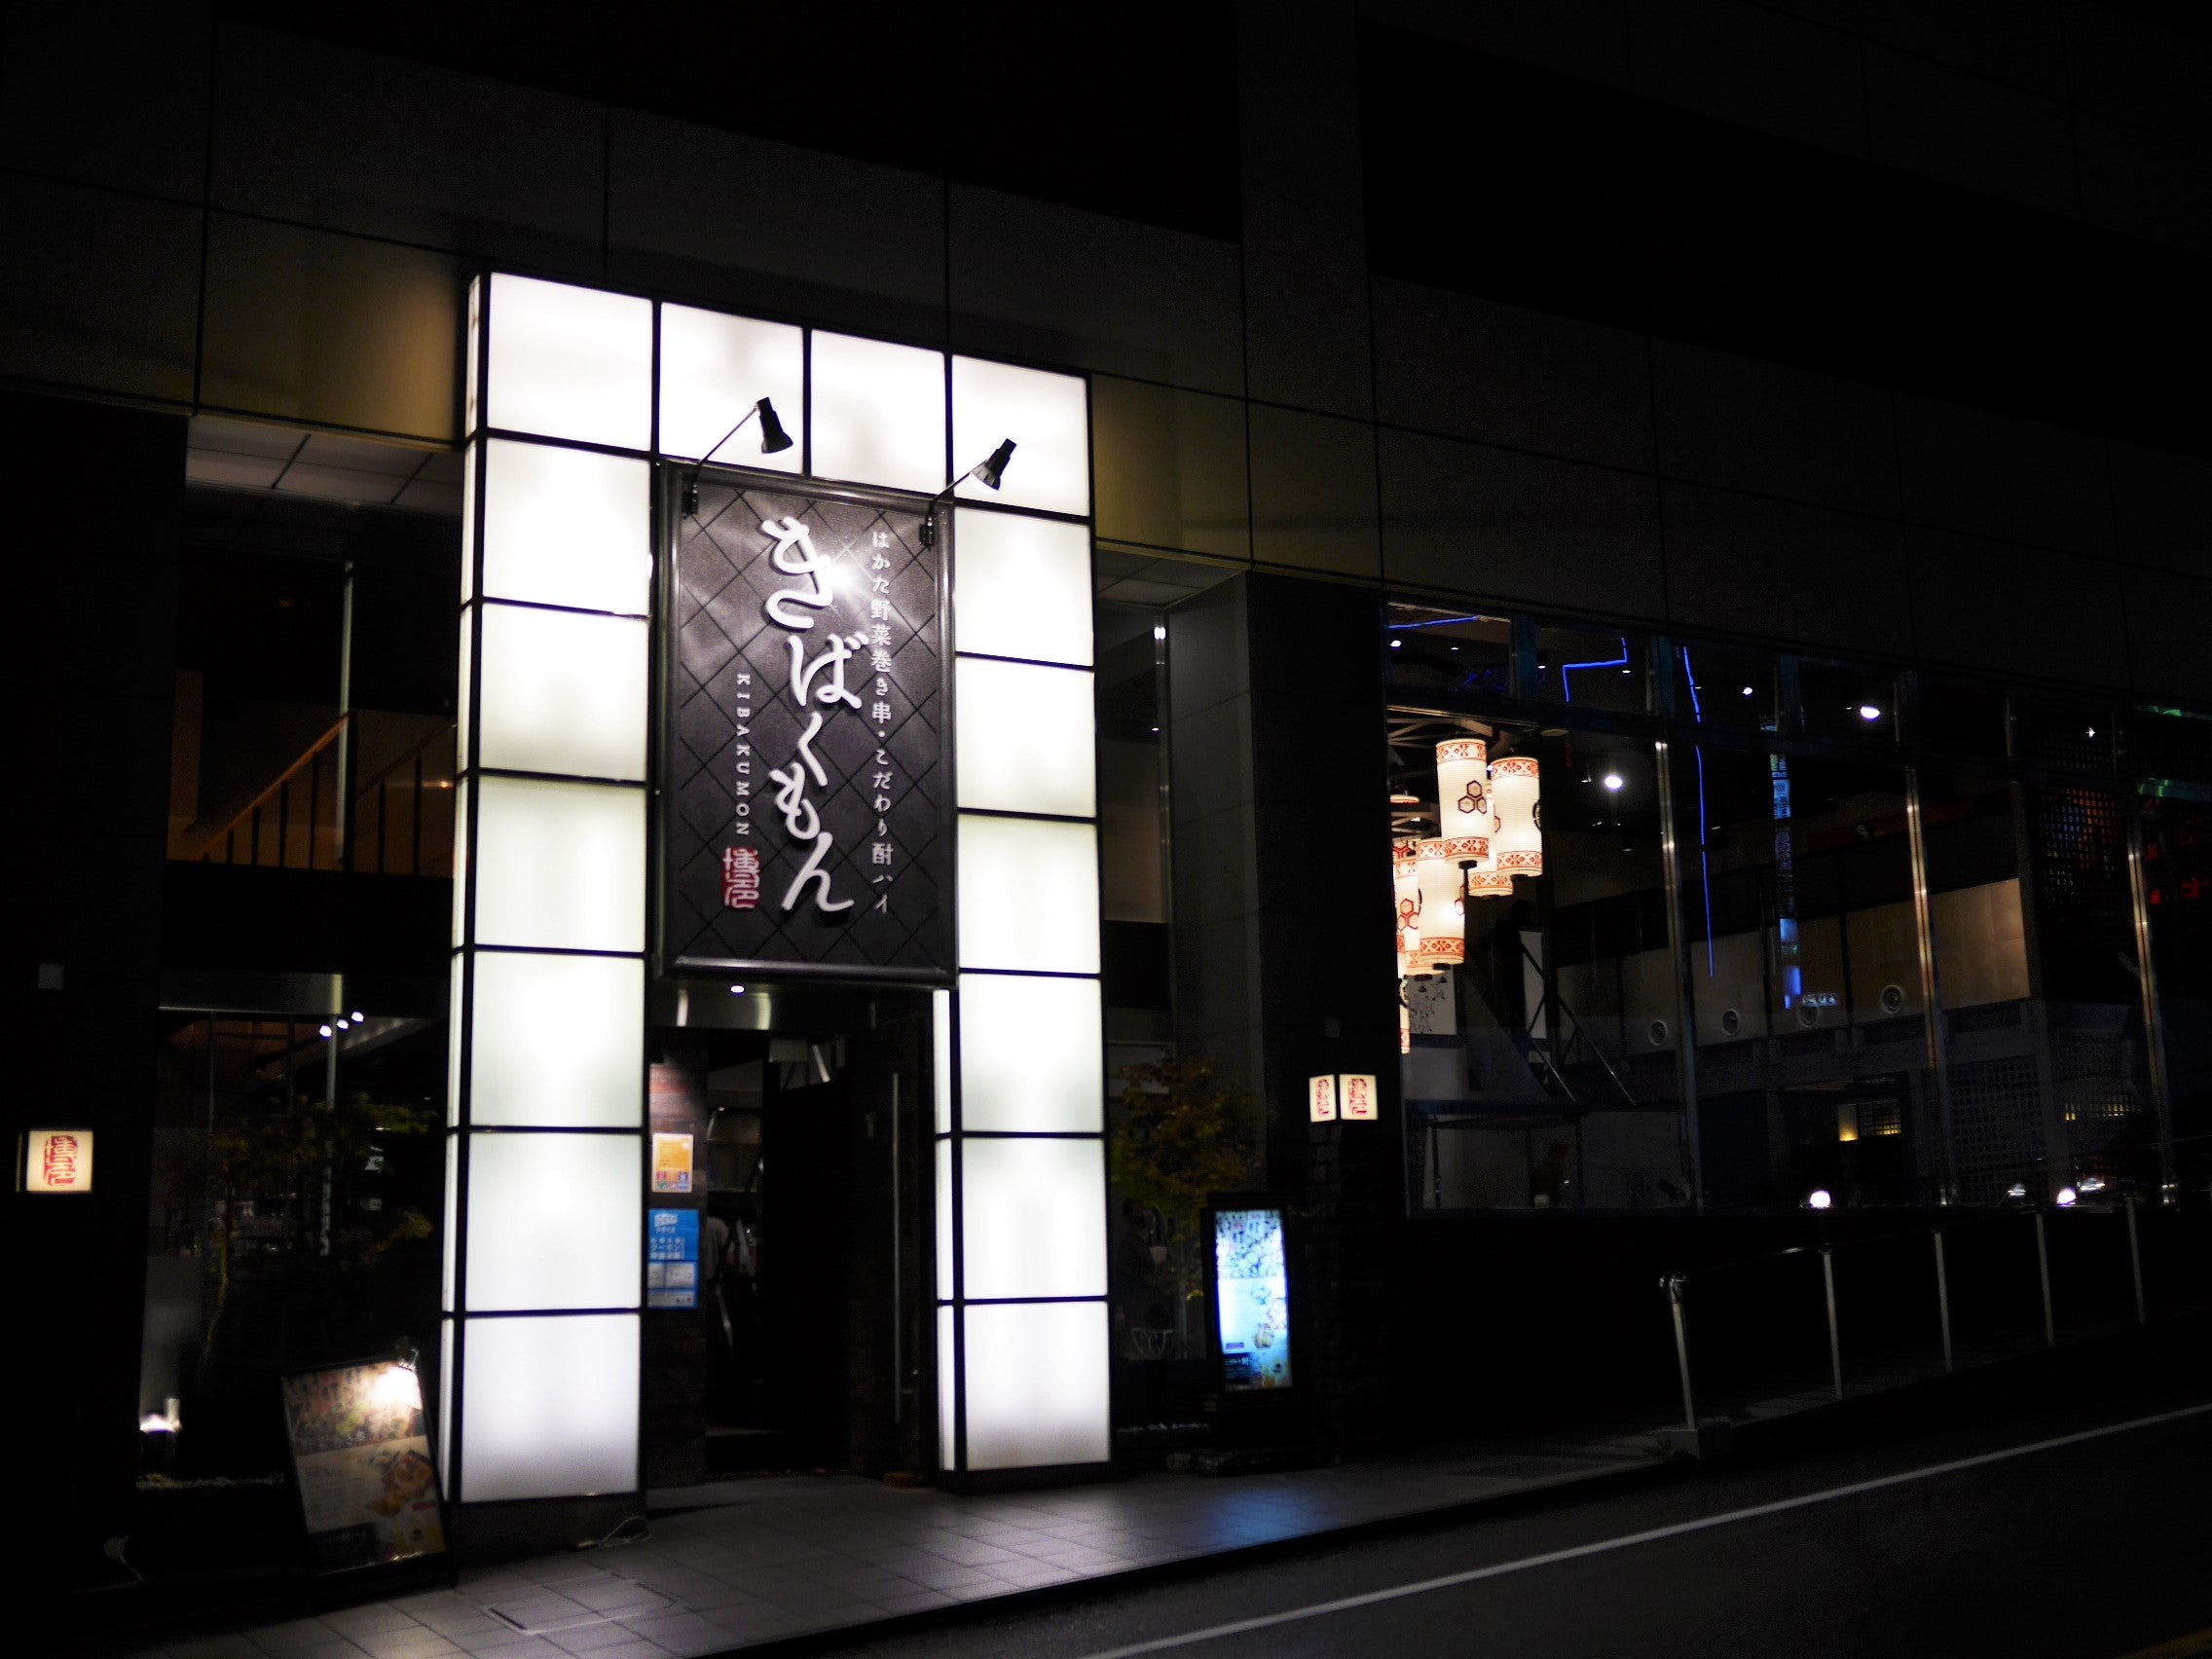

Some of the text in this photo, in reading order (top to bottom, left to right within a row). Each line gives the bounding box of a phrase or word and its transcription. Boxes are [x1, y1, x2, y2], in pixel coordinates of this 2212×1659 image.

[735, 673, 752, 837] KIBAKUMON
[762, 516, 869, 912] きばくもん
[871, 531, 894, 913] はかた野菜巻き串・こだわり酎ハイ
